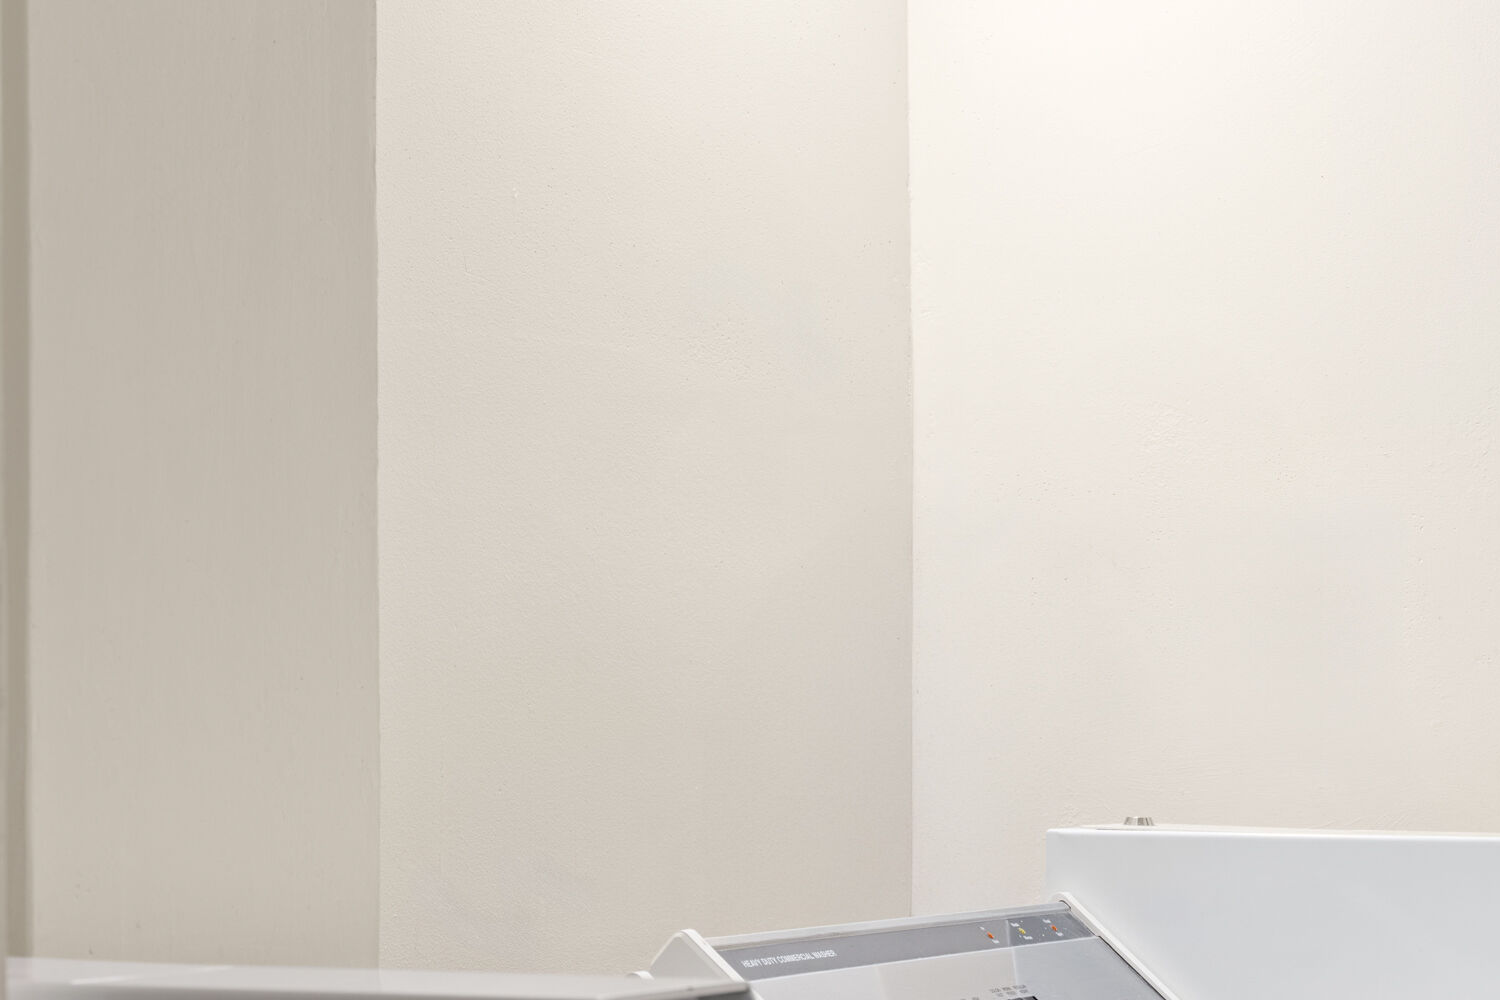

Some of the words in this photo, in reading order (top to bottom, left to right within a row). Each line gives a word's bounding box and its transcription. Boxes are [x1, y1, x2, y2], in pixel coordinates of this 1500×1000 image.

[741, 959, 762, 968] HEAVY
[761, 957, 777, 966] DUTY
[776, 953, 814, 963] COMMERCIAL
[812, 949, 838, 959] WASHER
